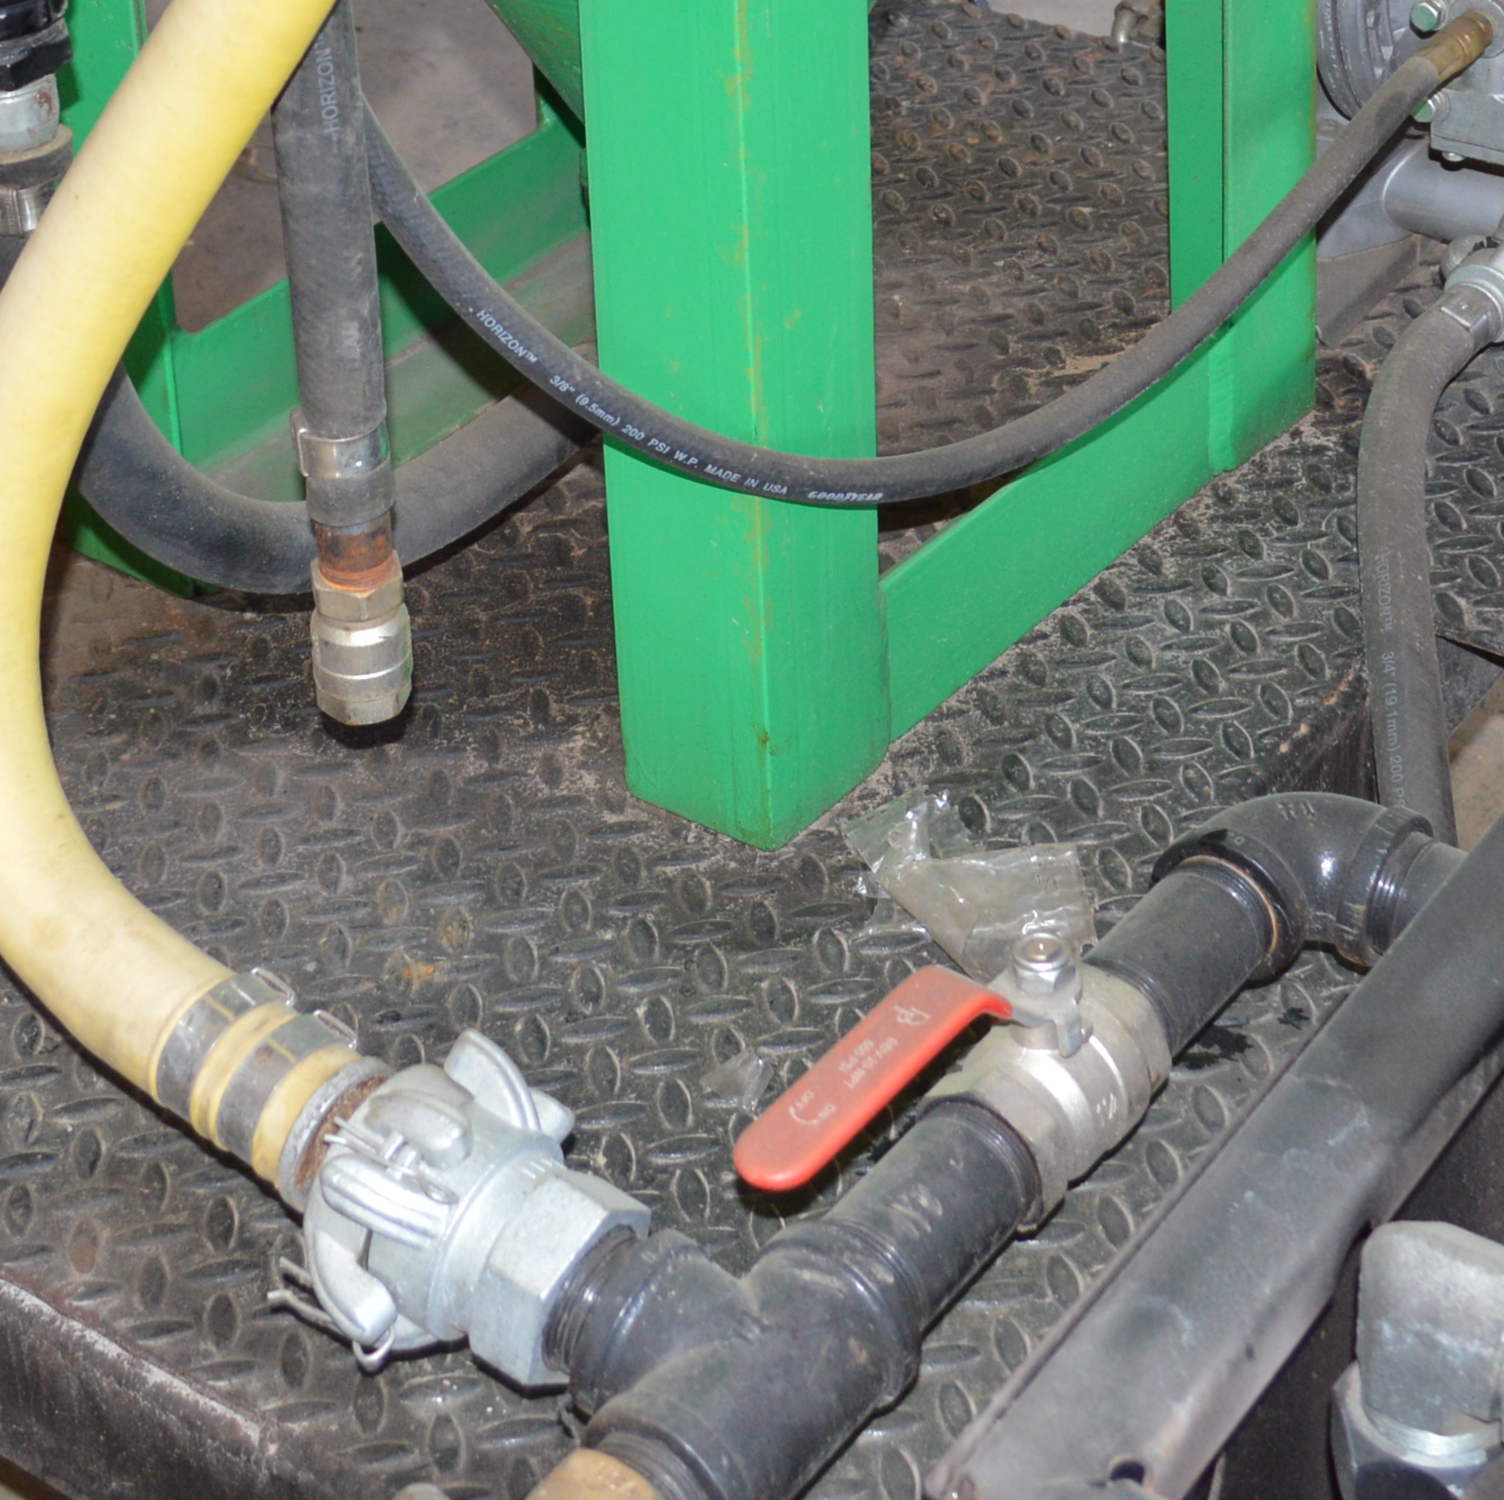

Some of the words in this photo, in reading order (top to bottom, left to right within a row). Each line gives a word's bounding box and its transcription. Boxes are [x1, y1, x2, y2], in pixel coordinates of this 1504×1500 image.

[575, 393, 622, 427] (9.5mm)
[621, 424, 645, 442] 200
[647, 438, 671, 455] PSI
[673, 450, 698, 469] W.P.
[704, 463, 742, 484] MADE
[744, 477, 760, 489] IN
[763, 482, 788, 496] USA
